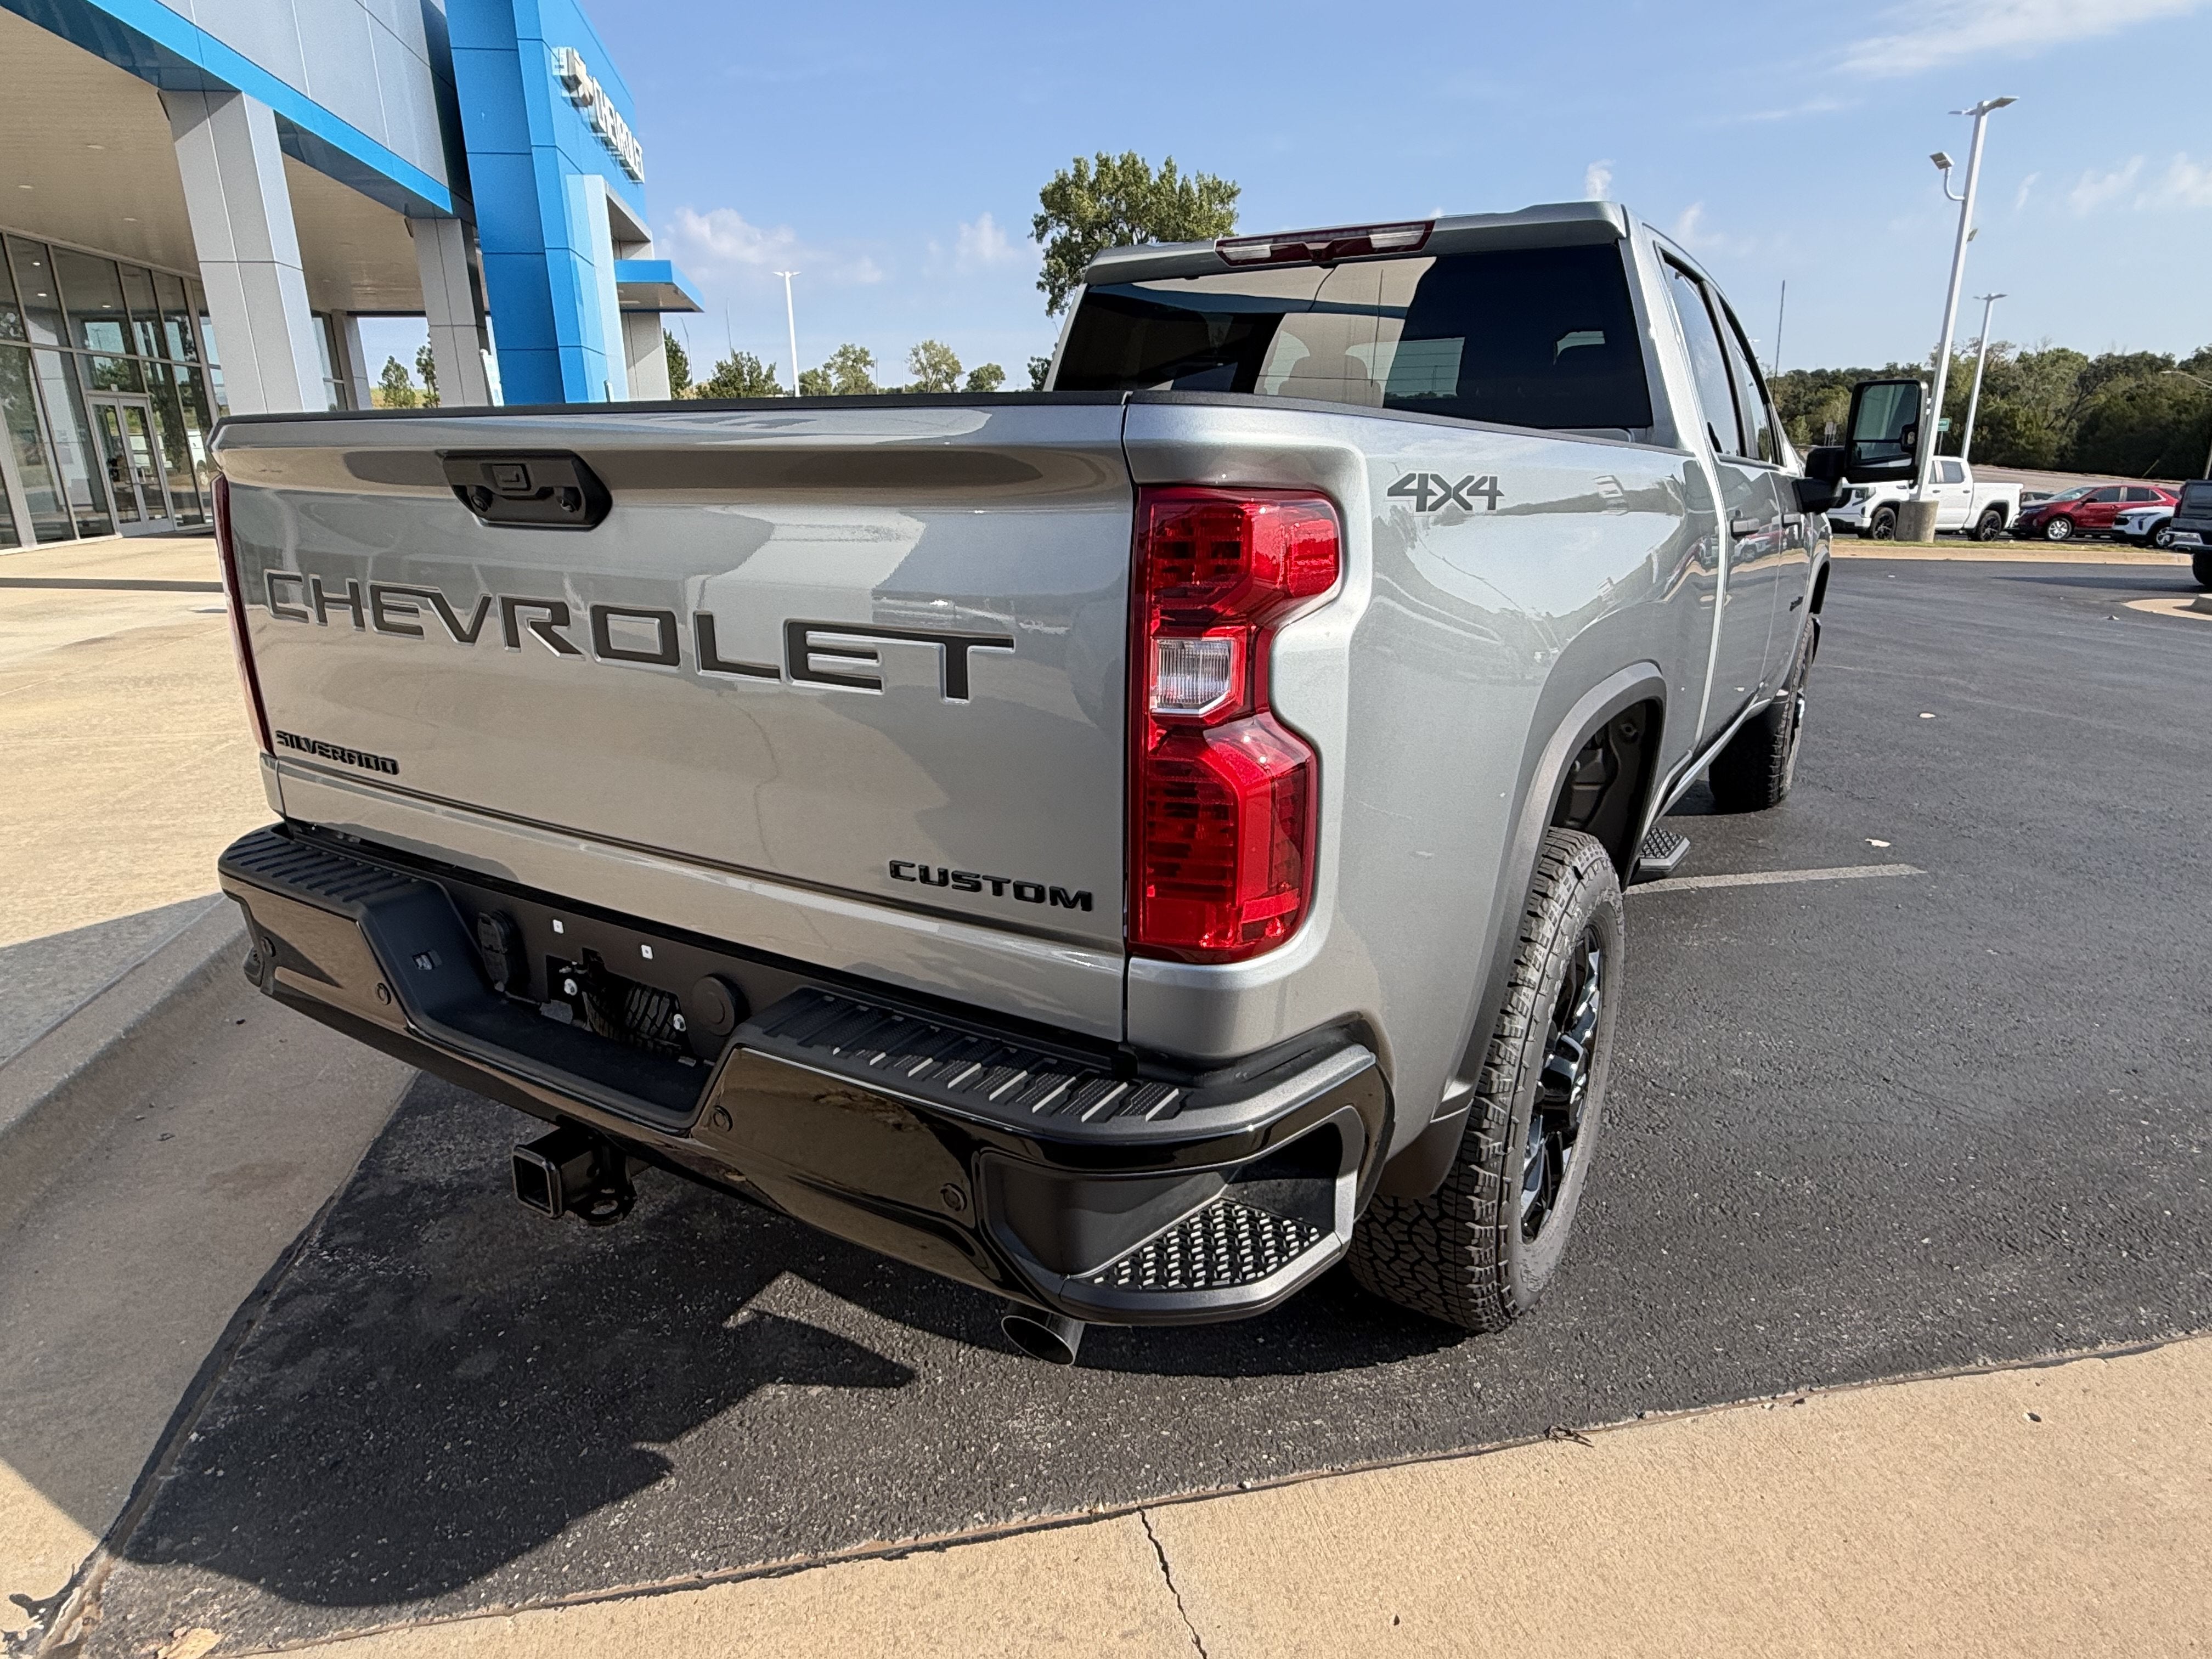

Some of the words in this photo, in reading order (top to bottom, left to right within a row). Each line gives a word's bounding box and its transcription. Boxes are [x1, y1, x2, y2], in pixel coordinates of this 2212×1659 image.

[266, 569, 1015, 703] CHEVROLET
[275, 730, 399, 775] SILVERADO
[889, 860, 1093, 912] CUSTOM
